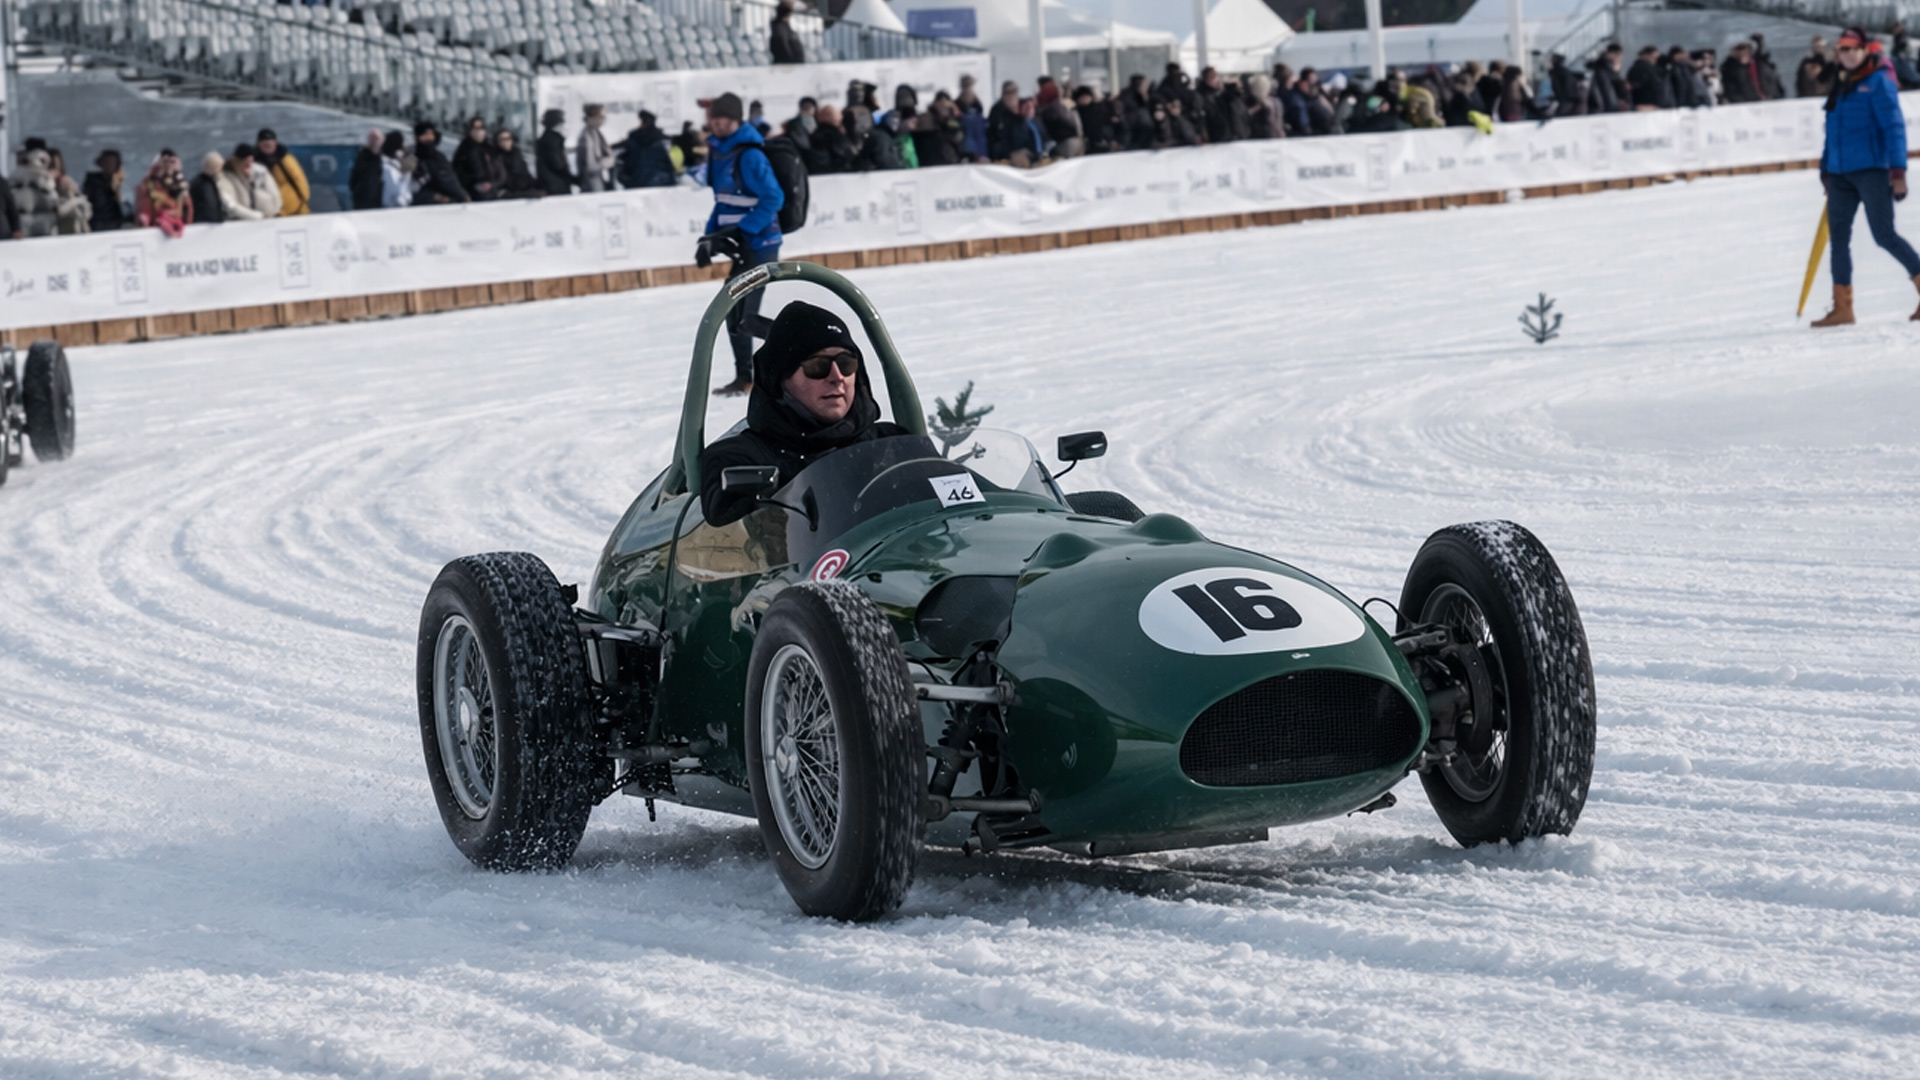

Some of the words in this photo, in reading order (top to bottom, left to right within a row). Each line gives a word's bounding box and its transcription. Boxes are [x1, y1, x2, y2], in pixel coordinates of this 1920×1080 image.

[165, 258, 219, 279] RICHARD
[221, 254, 258, 273] MILLE
[948, 486, 975, 501] 46
[1172, 578, 1303, 643] 16
